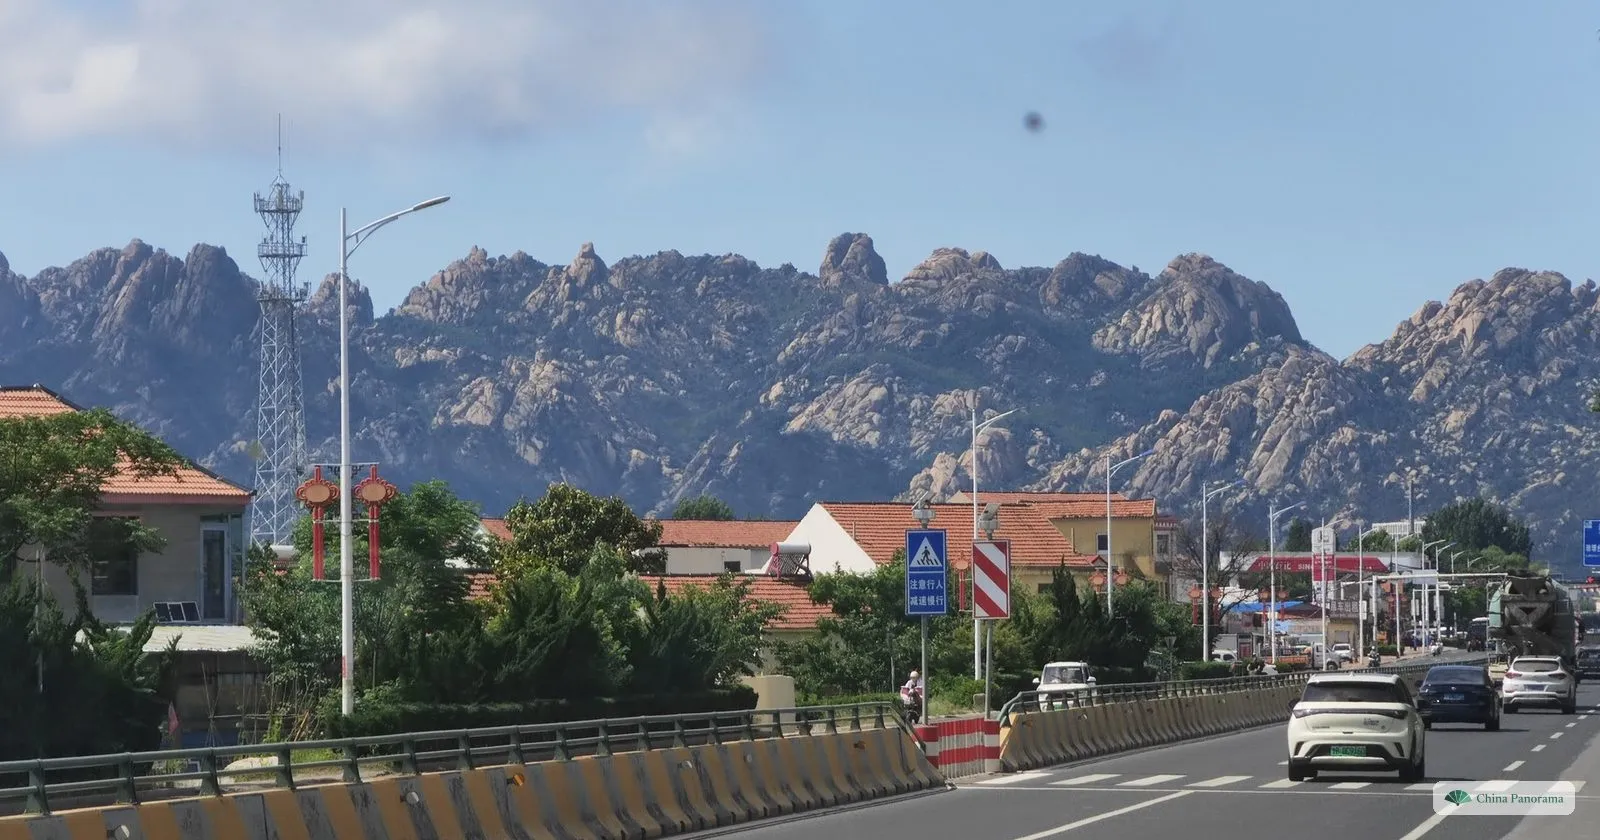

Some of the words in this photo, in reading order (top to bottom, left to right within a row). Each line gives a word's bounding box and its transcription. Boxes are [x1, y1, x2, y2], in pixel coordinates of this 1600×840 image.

[910, 579, 943, 590] 注意行人
[910, 595, 943, 606] 减速慢行
